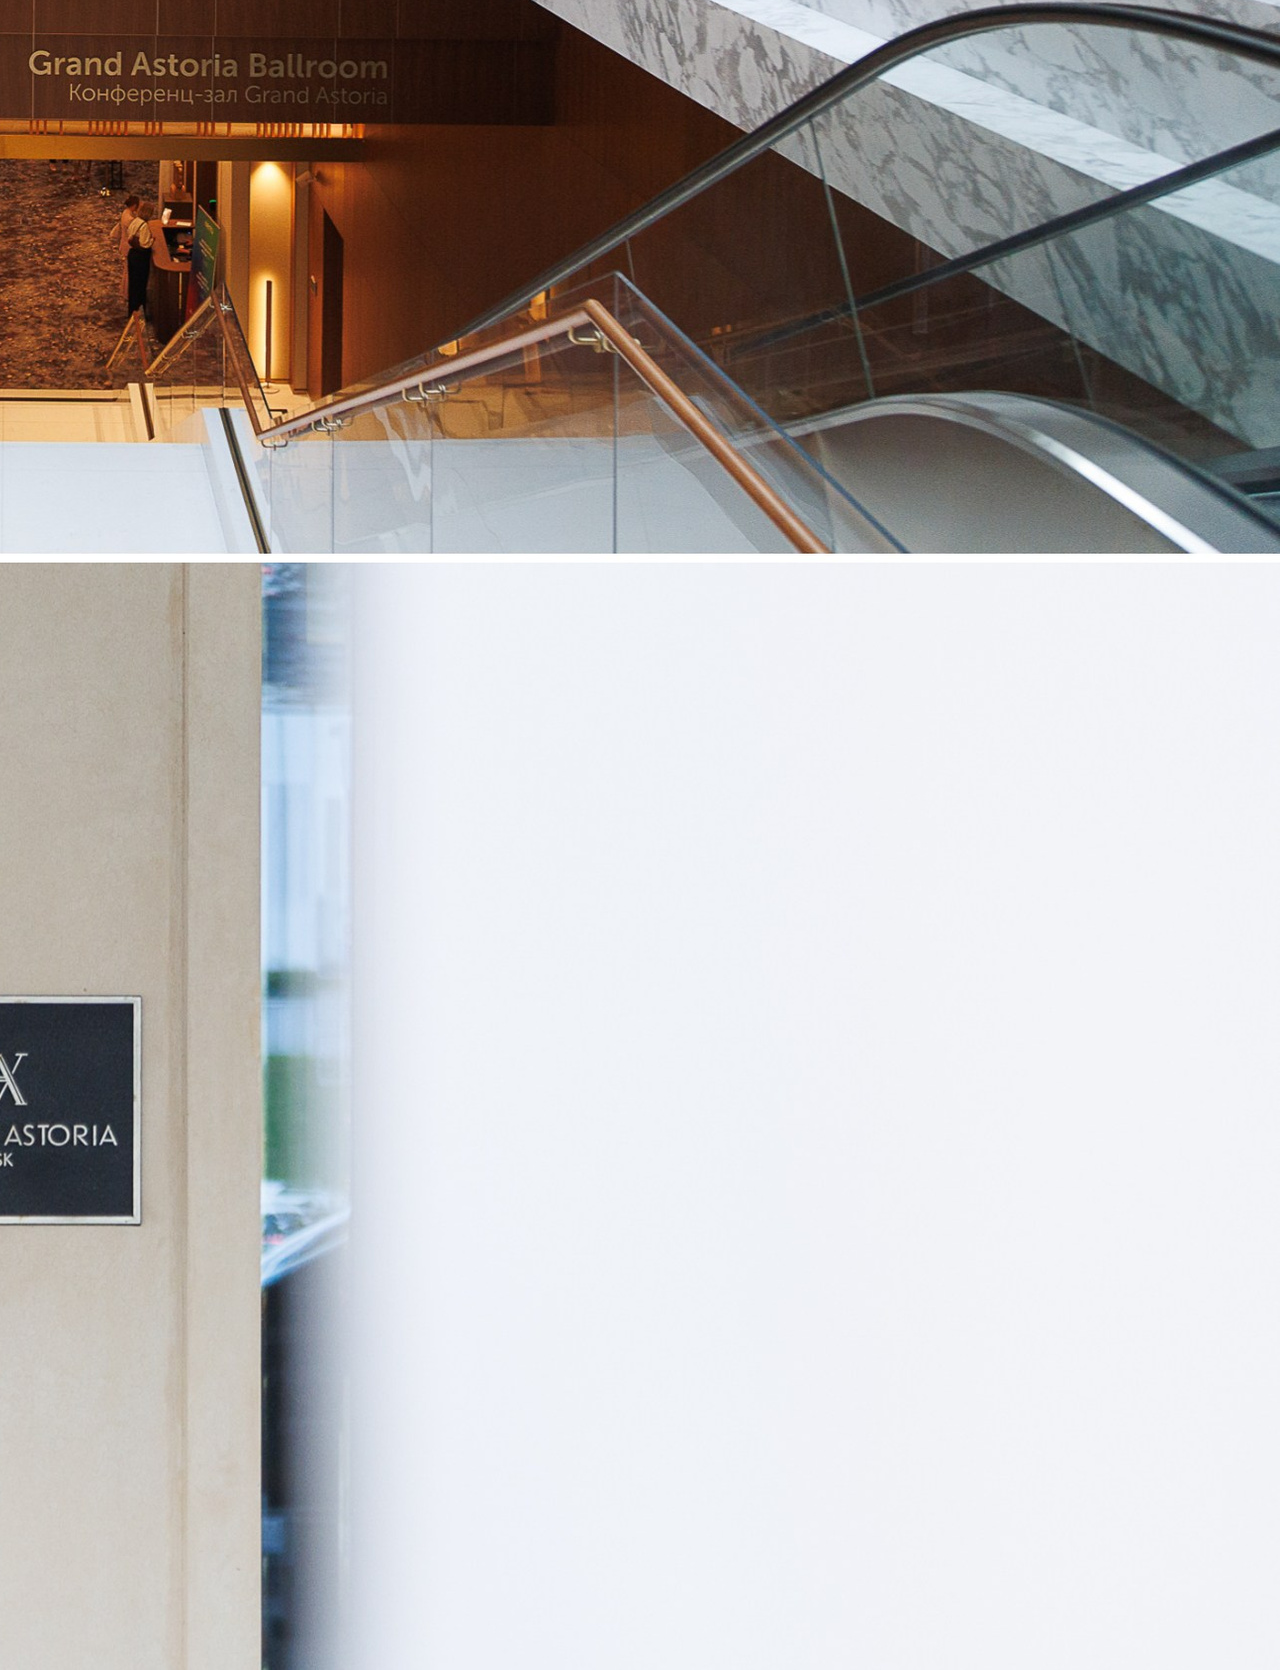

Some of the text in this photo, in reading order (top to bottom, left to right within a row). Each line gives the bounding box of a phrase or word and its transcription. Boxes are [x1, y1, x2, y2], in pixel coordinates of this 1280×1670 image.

[28, 50, 388, 79] Grand Astoria Ballroom
[69, 83, 388, 106] Конференц-зал Grand Astoria
[3, 1124, 118, 1146] ASTORIA
